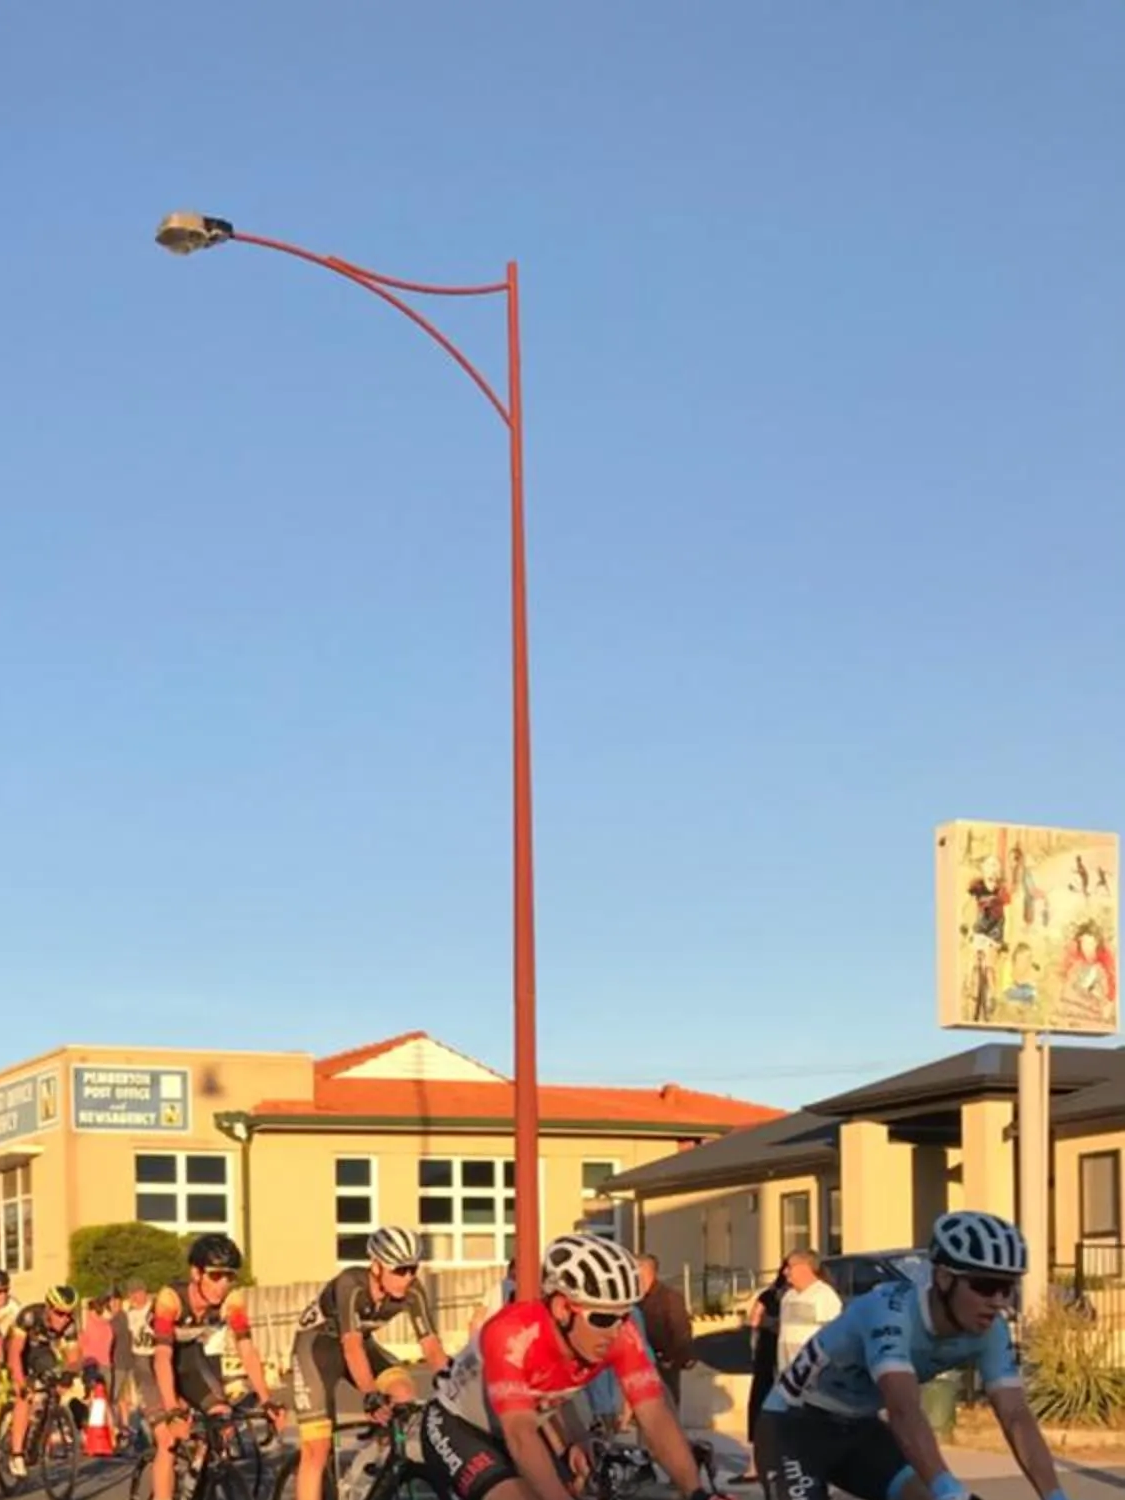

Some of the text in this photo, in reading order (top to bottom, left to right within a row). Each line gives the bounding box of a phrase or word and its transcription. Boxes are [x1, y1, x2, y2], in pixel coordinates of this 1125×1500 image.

[83, 1072, 150, 1085] PEMBERTON
[83, 1086, 150, 1100] POST OFFICE
[79, 1111, 156, 1125] NEWSAGENCY
